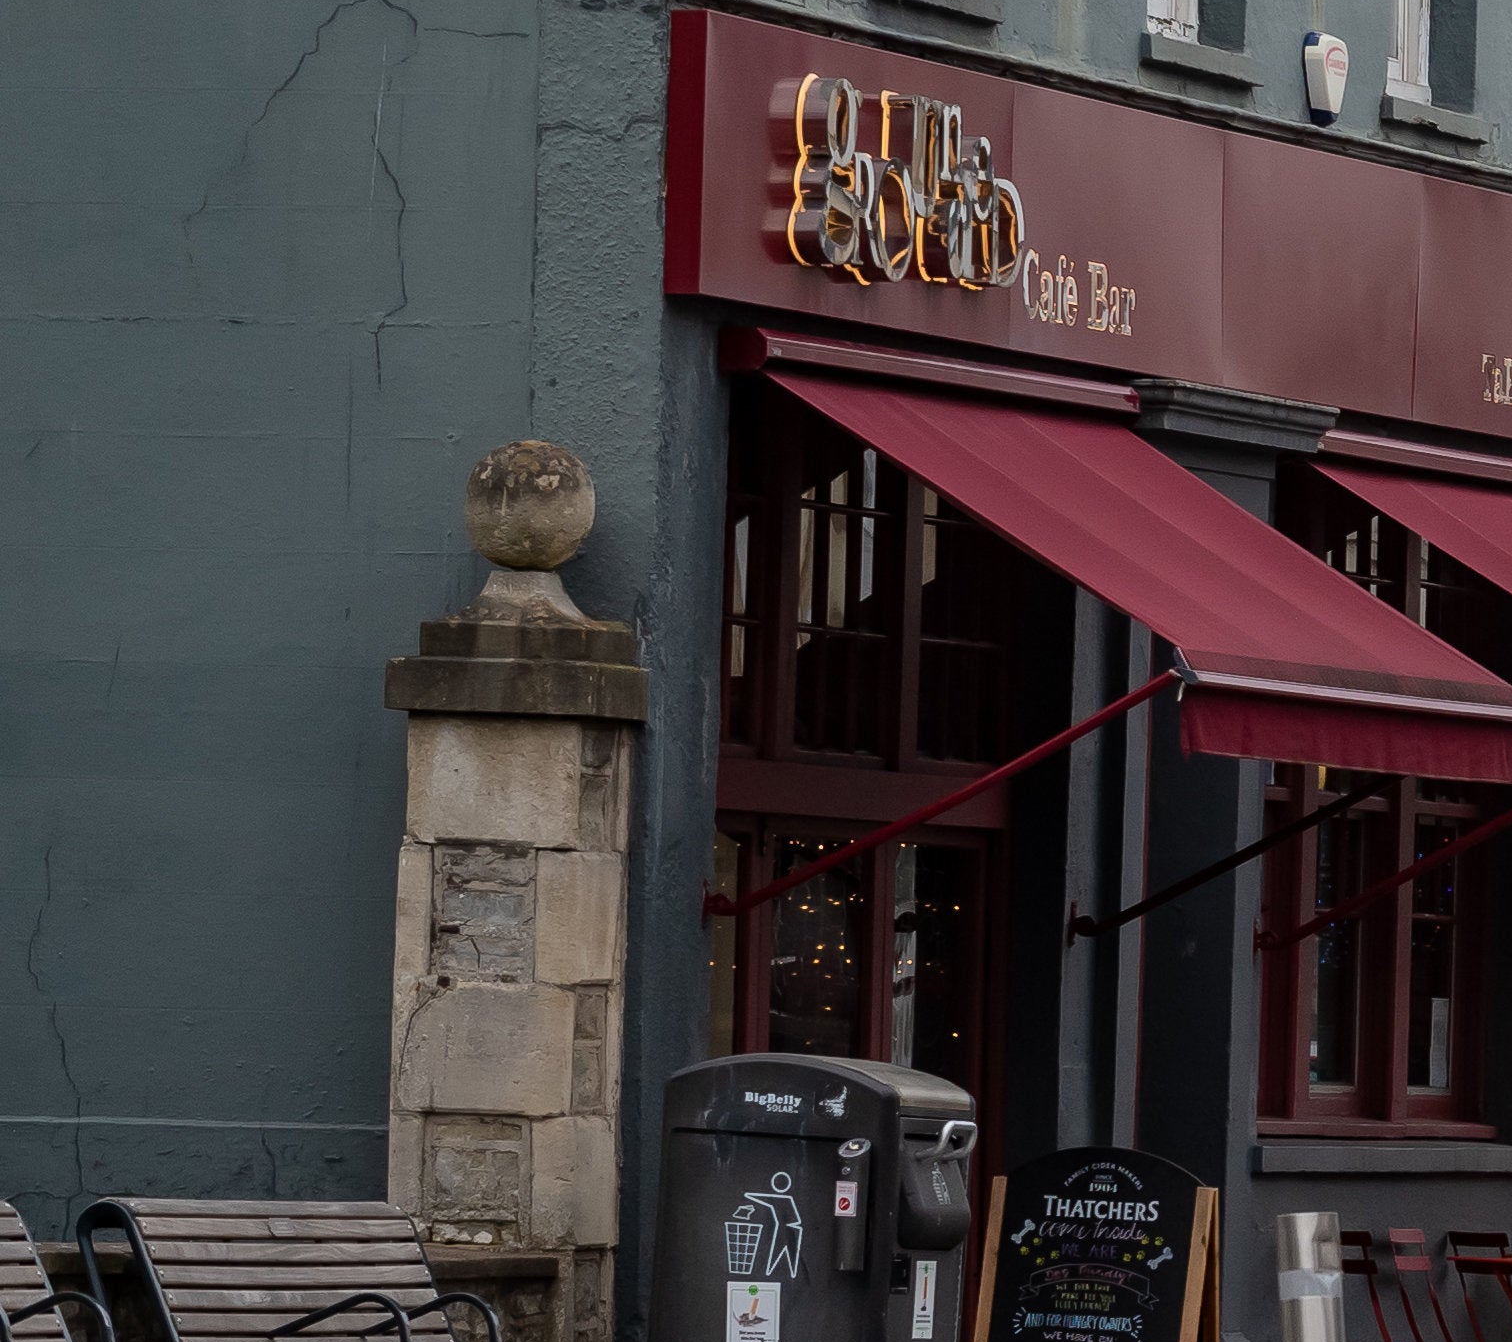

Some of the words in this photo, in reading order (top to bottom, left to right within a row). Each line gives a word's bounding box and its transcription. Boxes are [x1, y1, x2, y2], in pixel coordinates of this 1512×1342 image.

[1023, 248, 1079, 327] Café
[1087, 261, 1136, 336] Bar
[744, 1091, 802, 1107] BigBelly
[766, 1104, 794, 1113] SOLAR
[1091, 1162, 1116, 1170] CIDER
[1089, 1182, 1118, 1193] 1904
[1044, 1195, 1160, 1222] THATCHERS
